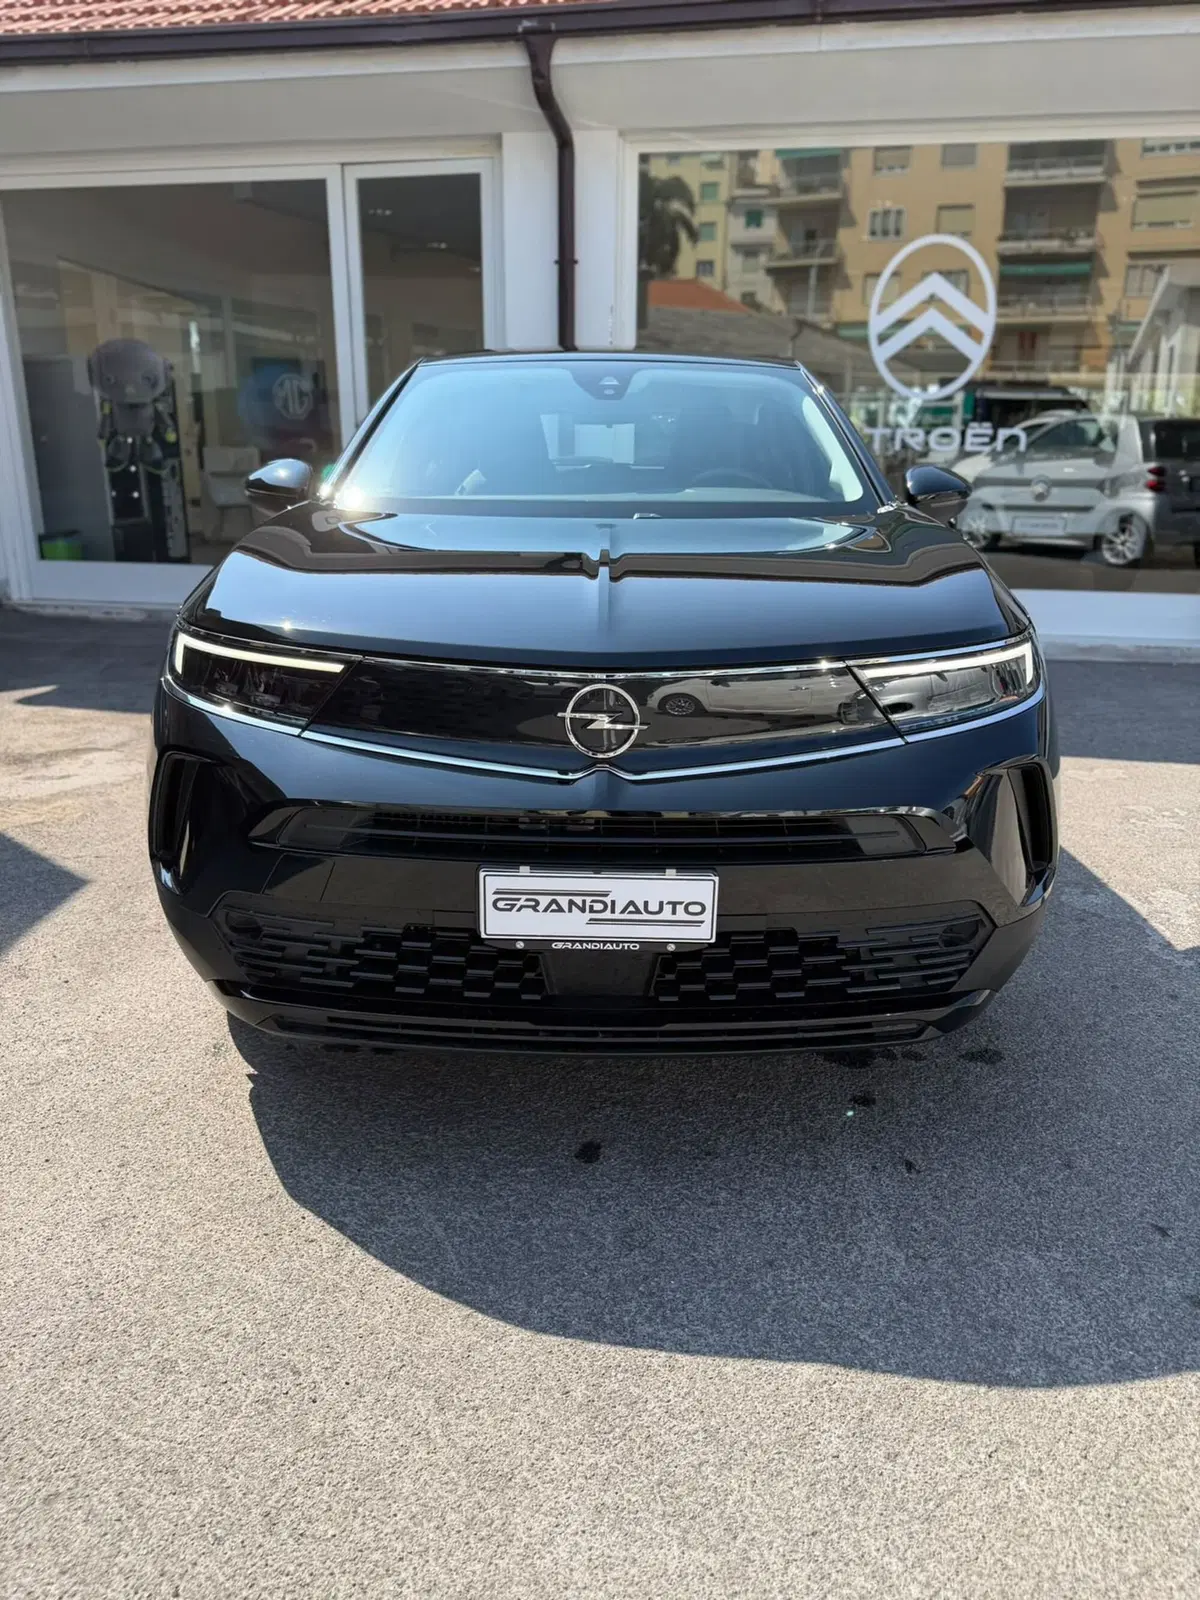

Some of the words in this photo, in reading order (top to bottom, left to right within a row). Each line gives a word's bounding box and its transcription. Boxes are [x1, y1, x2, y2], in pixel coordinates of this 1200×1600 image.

[273, 375, 312, 419] MG
[862, 422, 1027, 452] TROËN
[492, 897, 707, 917] GRANDIAUTO
[551, 942, 640, 951] GRANDIAUTO
